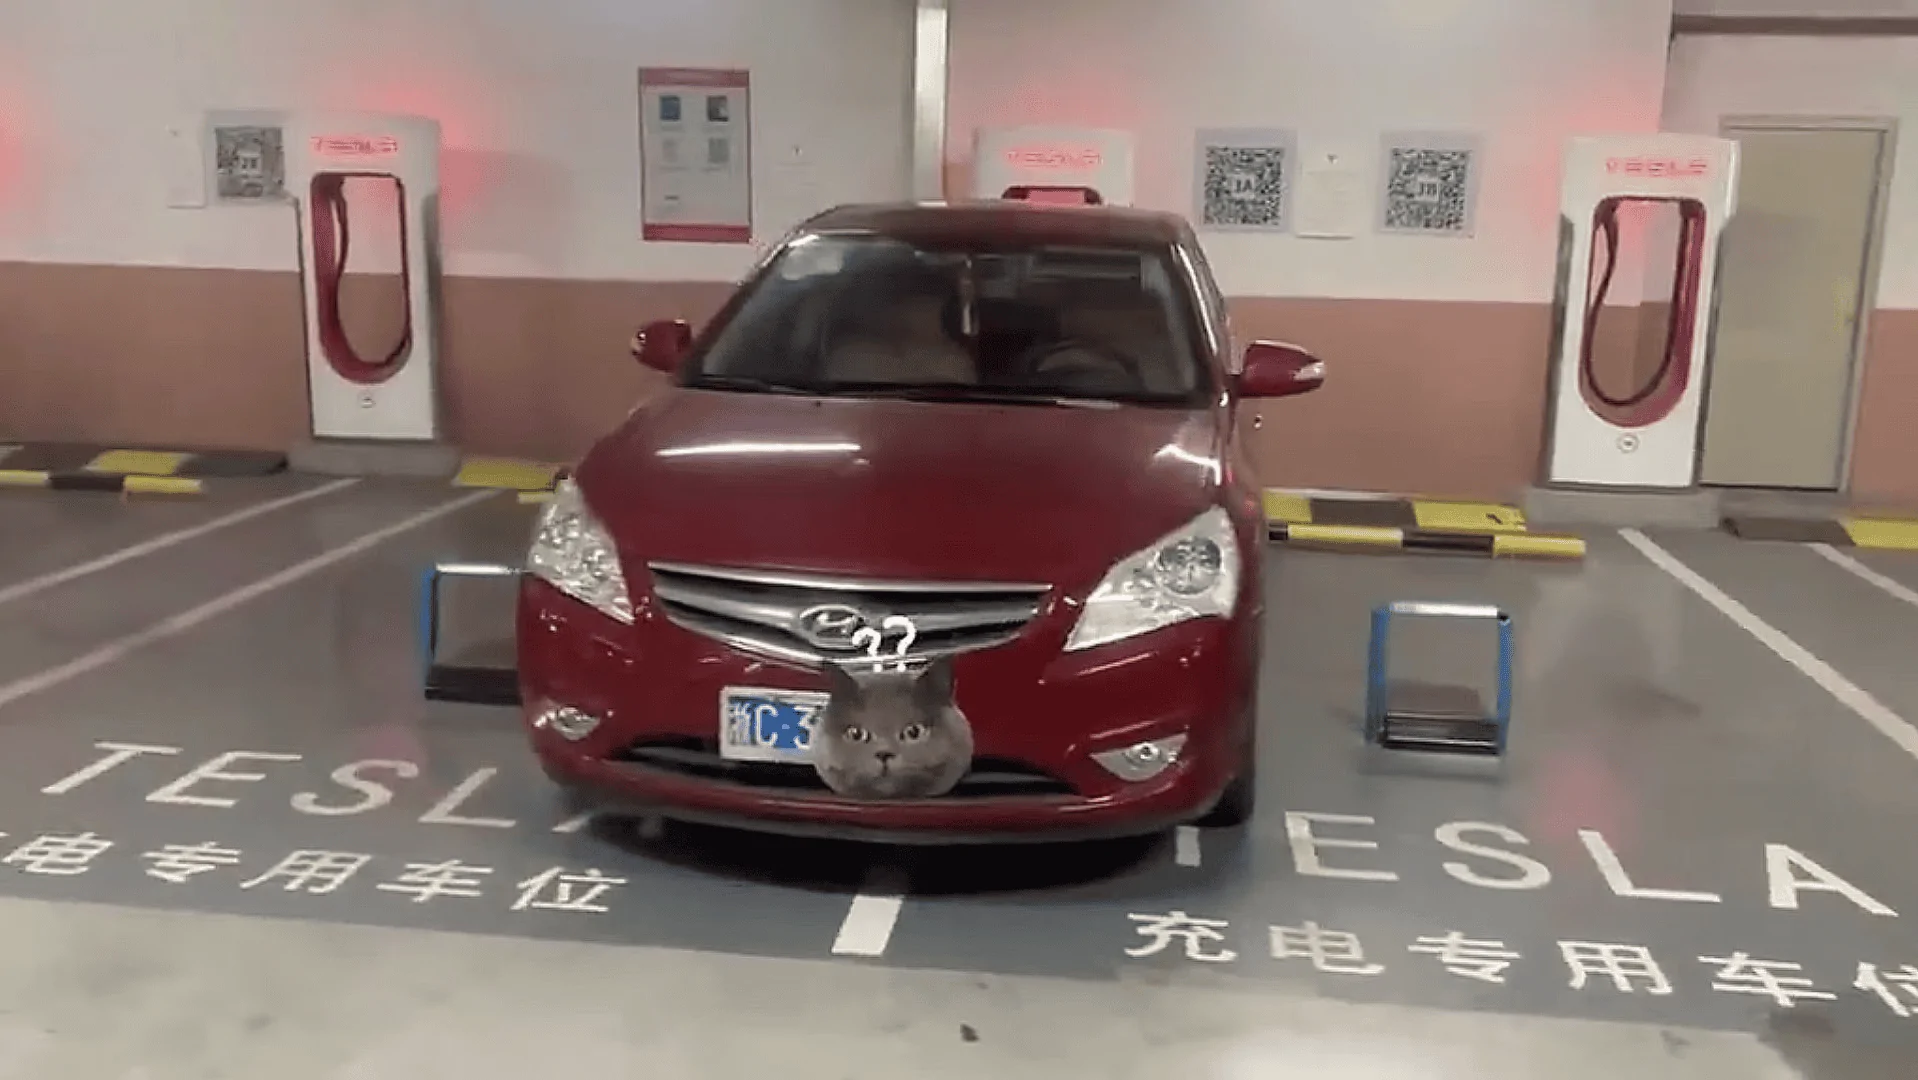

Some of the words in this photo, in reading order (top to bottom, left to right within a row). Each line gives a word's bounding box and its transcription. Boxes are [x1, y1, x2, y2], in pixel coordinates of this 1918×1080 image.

[41, 740, 662, 838] TESL
[0, 831, 628, 913] 电专用车位
